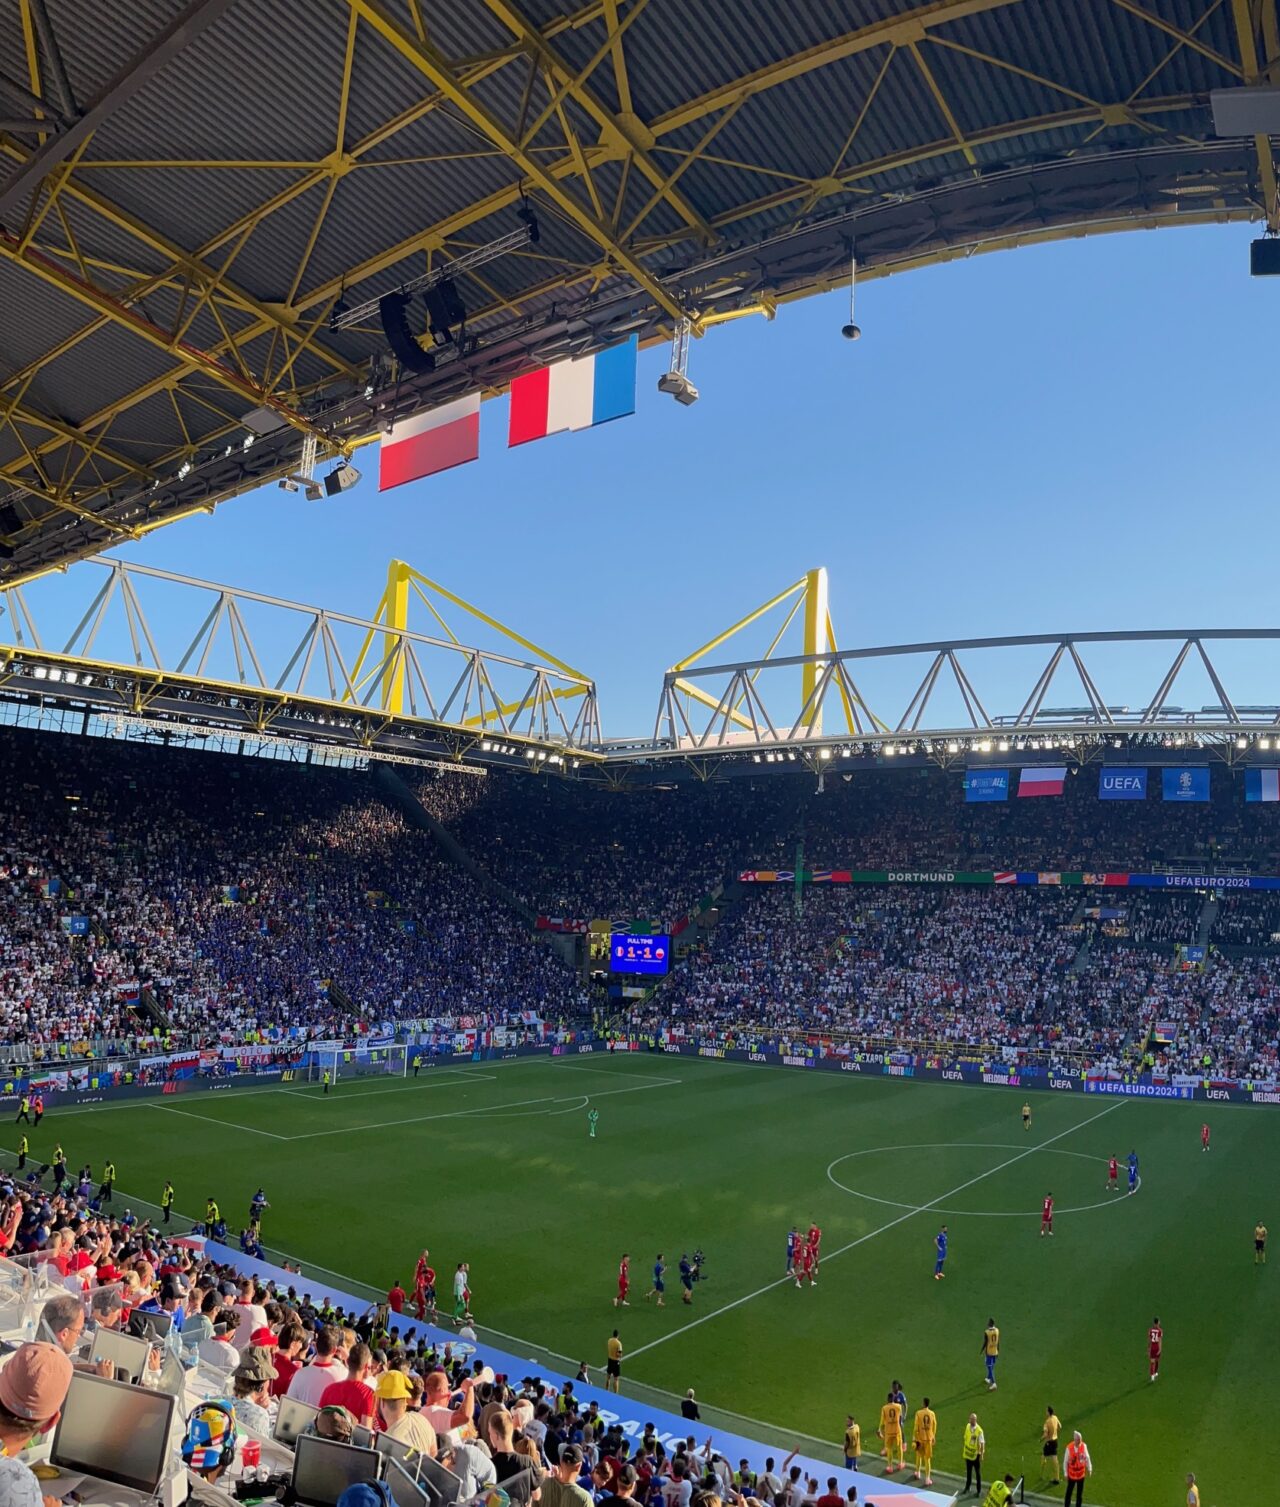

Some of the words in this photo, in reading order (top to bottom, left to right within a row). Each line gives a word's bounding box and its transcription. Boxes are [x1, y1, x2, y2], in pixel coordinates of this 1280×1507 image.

[1103, 777, 1141, 789] UEFA
[888, 872, 955, 882] DORTMUND
[74, 922, 86, 930] 13
[579, 1044, 593, 1053] UEFA
[664, 1044, 680, 1053] UEFA
[748, 1053, 767, 1062] UEFA
[783, 1056, 806, 1067] WELCOME
[841, 1061, 861, 1072] UEFA
[942, 1070, 963, 1081] UEFA
[982, 1073, 1009, 1085] WELCOME
[1008, 1075, 1021, 1086] ALL
[1050, 1079, 1072, 1090] UEFA
[1206, 1089, 1230, 1100] UEFA
[1252, 1091, 1280, 1103] WELCOME
